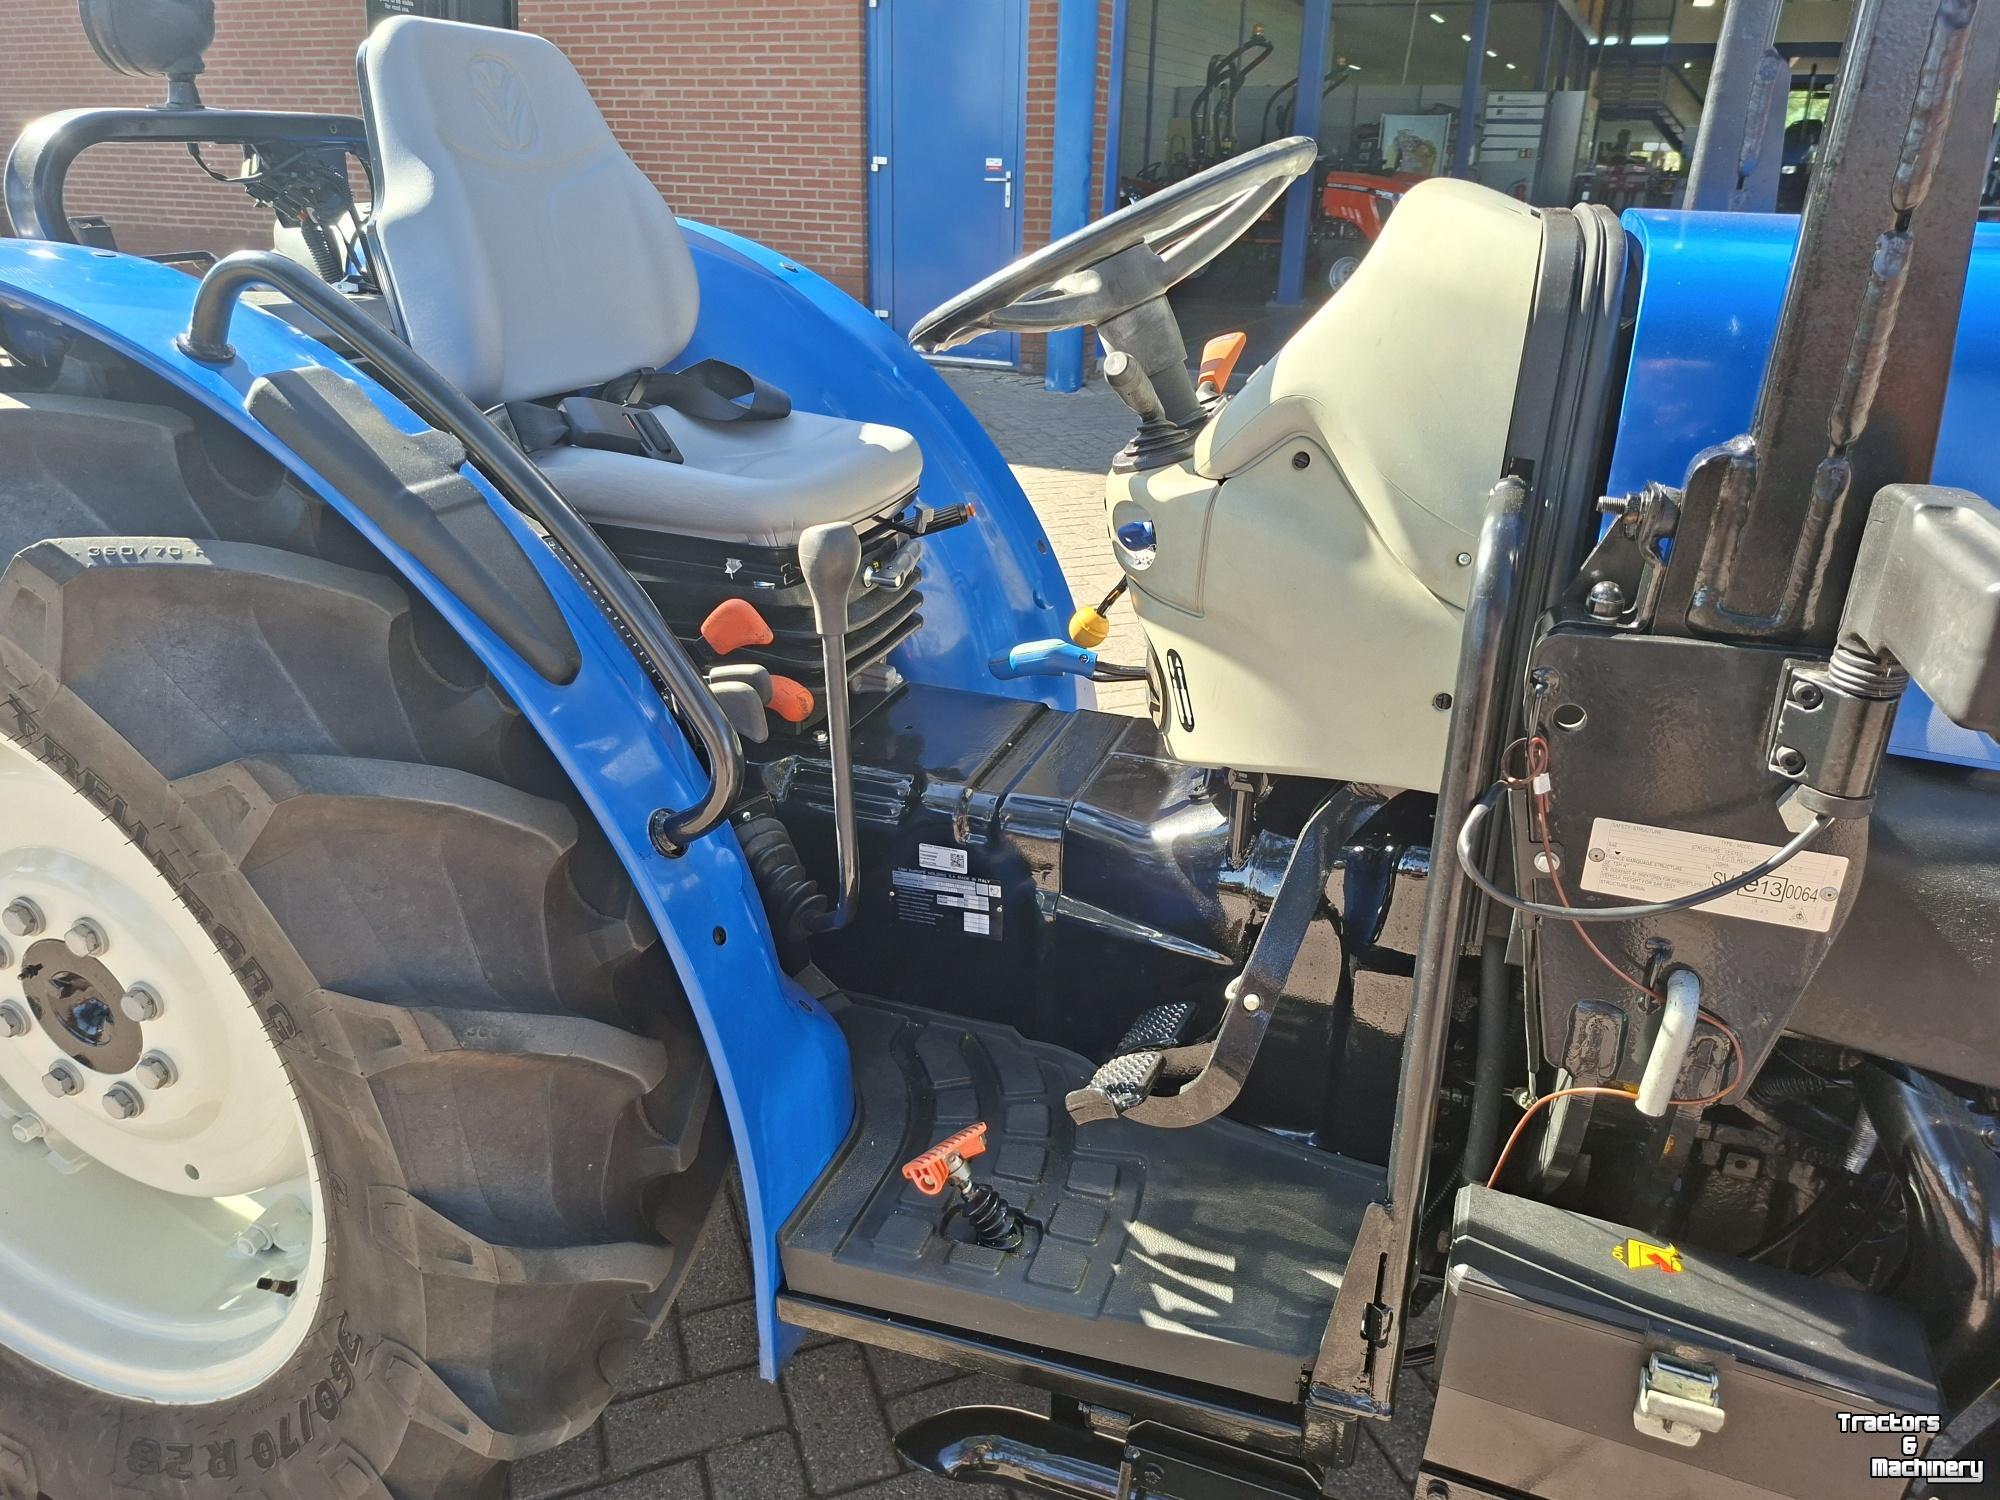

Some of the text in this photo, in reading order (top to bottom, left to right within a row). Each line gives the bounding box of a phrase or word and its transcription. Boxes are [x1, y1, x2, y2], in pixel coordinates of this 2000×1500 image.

[87, 546, 182, 557] 360/70
[1785, 884, 1819, 903] 0064
[252, 1310, 361, 1469] 360/70
